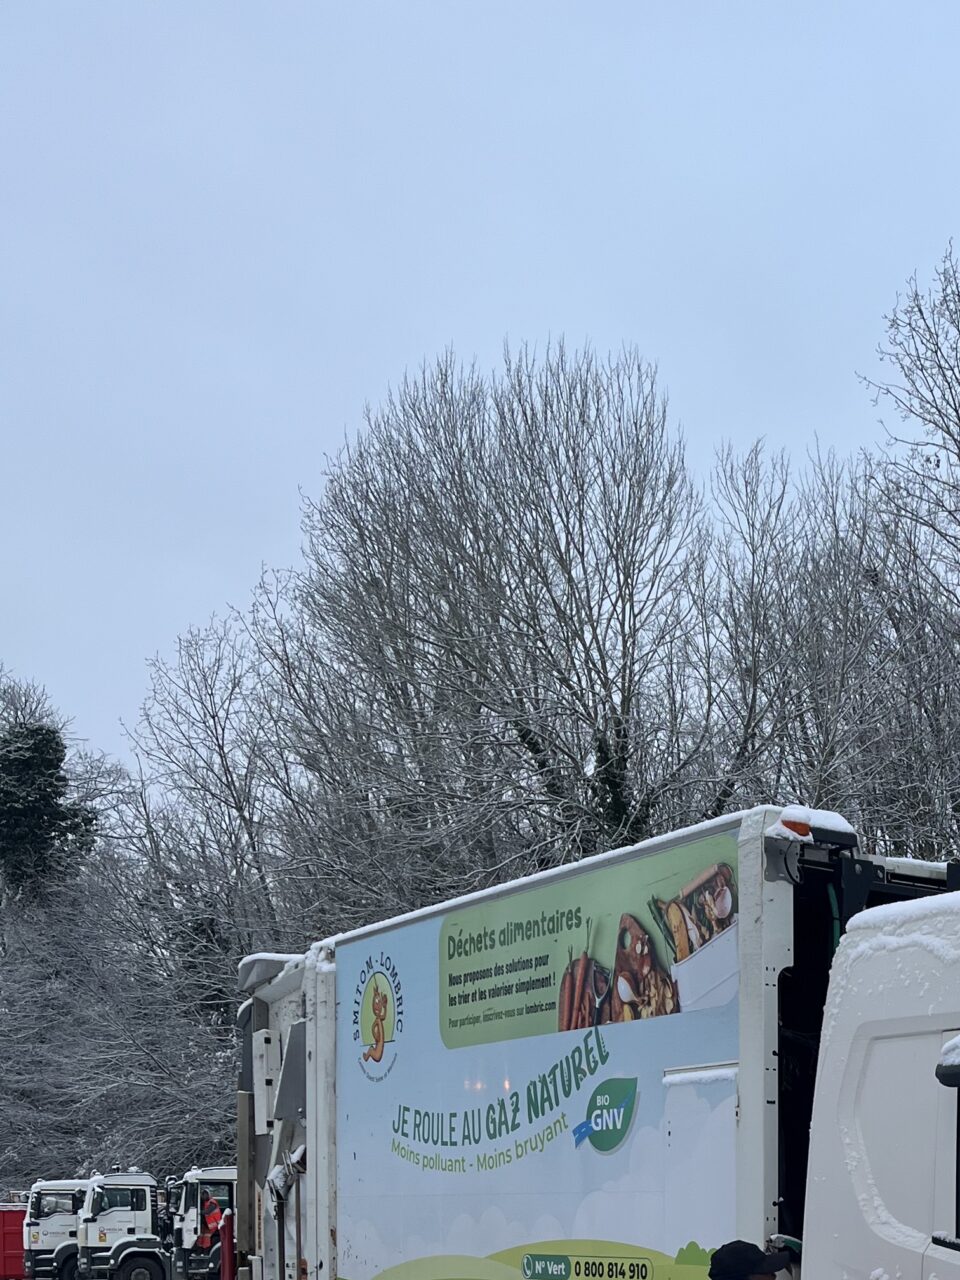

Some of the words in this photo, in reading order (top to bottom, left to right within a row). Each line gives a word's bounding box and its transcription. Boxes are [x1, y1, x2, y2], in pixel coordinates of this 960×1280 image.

[446, 926, 496, 961] Déchets
[498, 906, 582, 947] alimentaires
[448, 973, 462, 987] Nous
[463, 967, 493, 986] proposons
[494, 962, 504, 976] des
[505, 957, 533, 974] solutions
[534, 954, 549, 971] pour
[448, 993, 457, 1007] les
[458, 990, 471, 1006] trier
[471, 988, 478, 1002] et
[478, 987, 487, 1001] les
[488, 982, 514, 999] valoriser
[515, 974, 552, 995] simplement
[525, 1001, 556, 1014] lombric.com
[392, 1104, 409, 1139] JE
[413, 1109, 458, 1146] ROULE
[461, 1108, 481, 1145] AU
[486, 1091, 521, 1140] GAZ
[526, 1024, 610, 1124] NATUREL
[596, 1094, 610, 1106] BIO
[591, 1107, 624, 1132] GNV
[391, 1138, 420, 1166] Moins
[422, 1154, 466, 1173] polluant
[477, 1148, 513, 1172] Moins
[515, 1112, 569, 1158] bruyant
[547, 1261, 566, 1275] Vert
[574, 1261, 581, 1277] 0
[584, 1261, 604, 1278] 800
[607, 1262, 626, 1279] 814
[628, 1263, 648, 1280] 910
